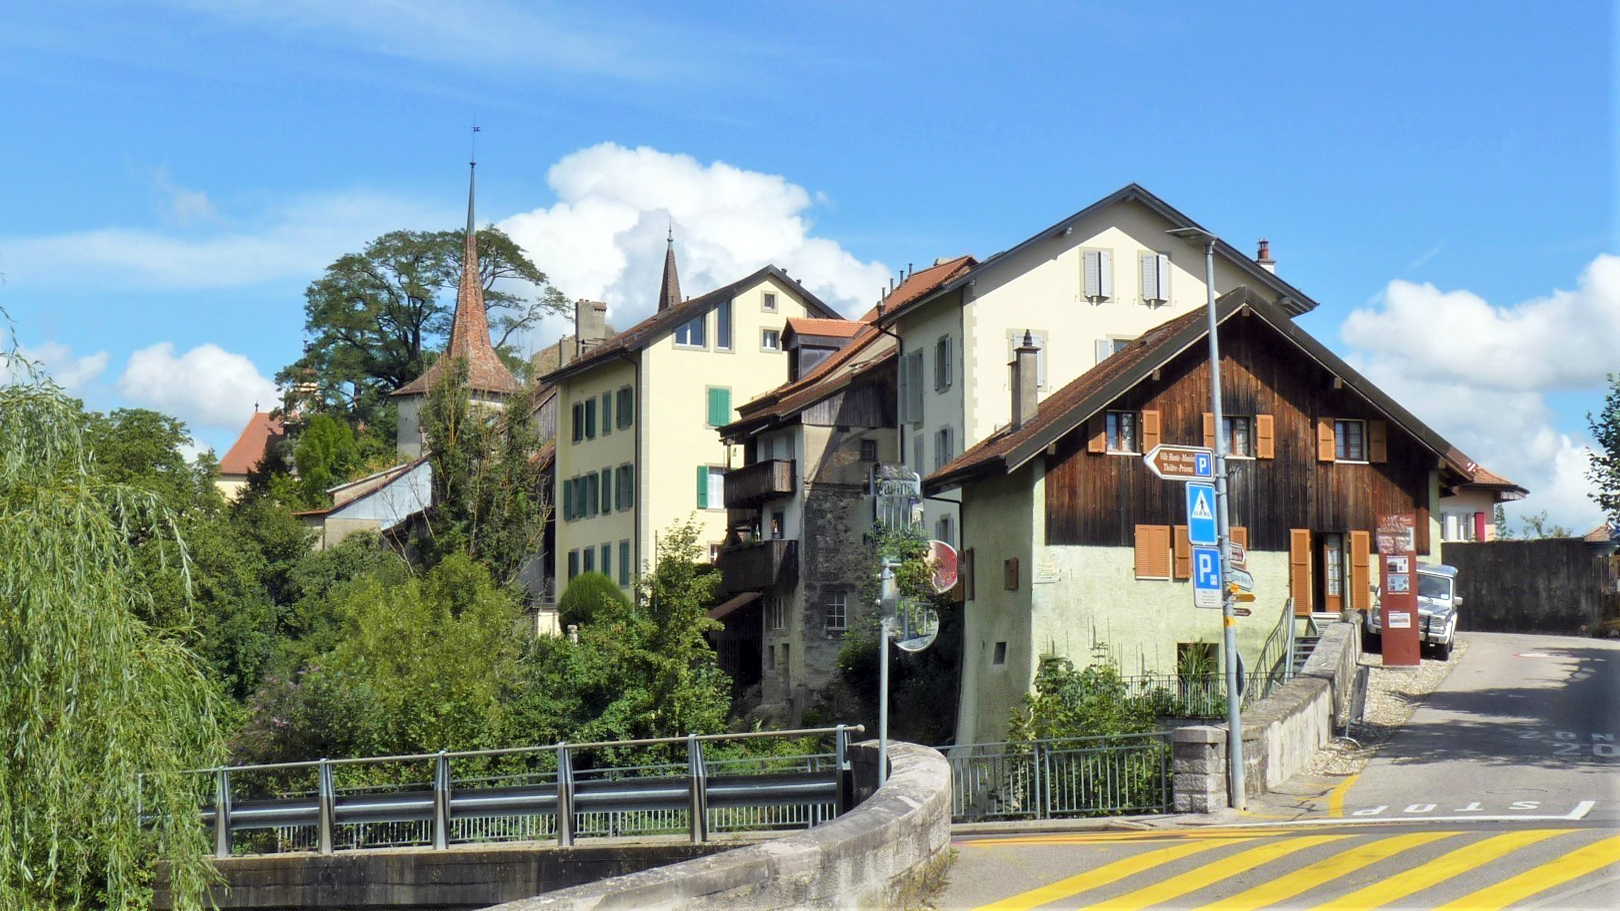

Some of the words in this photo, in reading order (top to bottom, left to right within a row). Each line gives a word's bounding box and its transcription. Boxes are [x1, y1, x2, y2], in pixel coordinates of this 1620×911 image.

[1199, 457, 1206, 473] P
[1199, 553, 1212, 583] P
[1351, 800, 1541, 816] STOP
